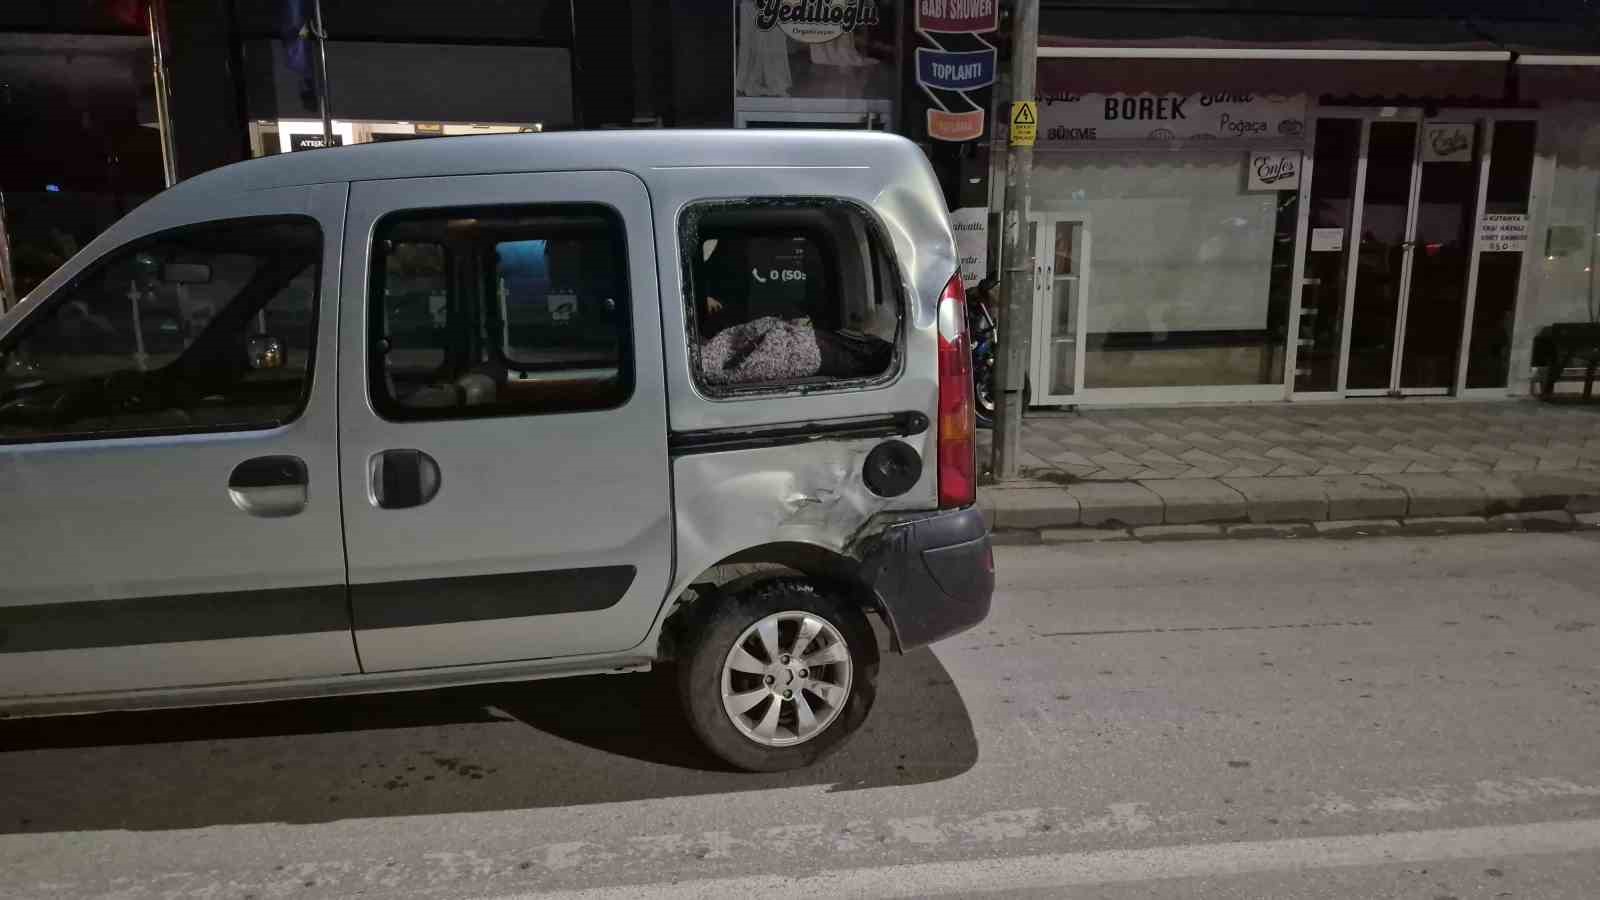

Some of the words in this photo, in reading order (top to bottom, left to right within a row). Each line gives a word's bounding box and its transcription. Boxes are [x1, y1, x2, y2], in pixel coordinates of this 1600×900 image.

[921, 0, 948, 18] BABY
[950, 0, 993, 19] SHOWER
[931, 62, 982, 81] TOPLANTI
[1254, 154, 1295, 182] Enfes
[769, 269, 779, 281] 0
